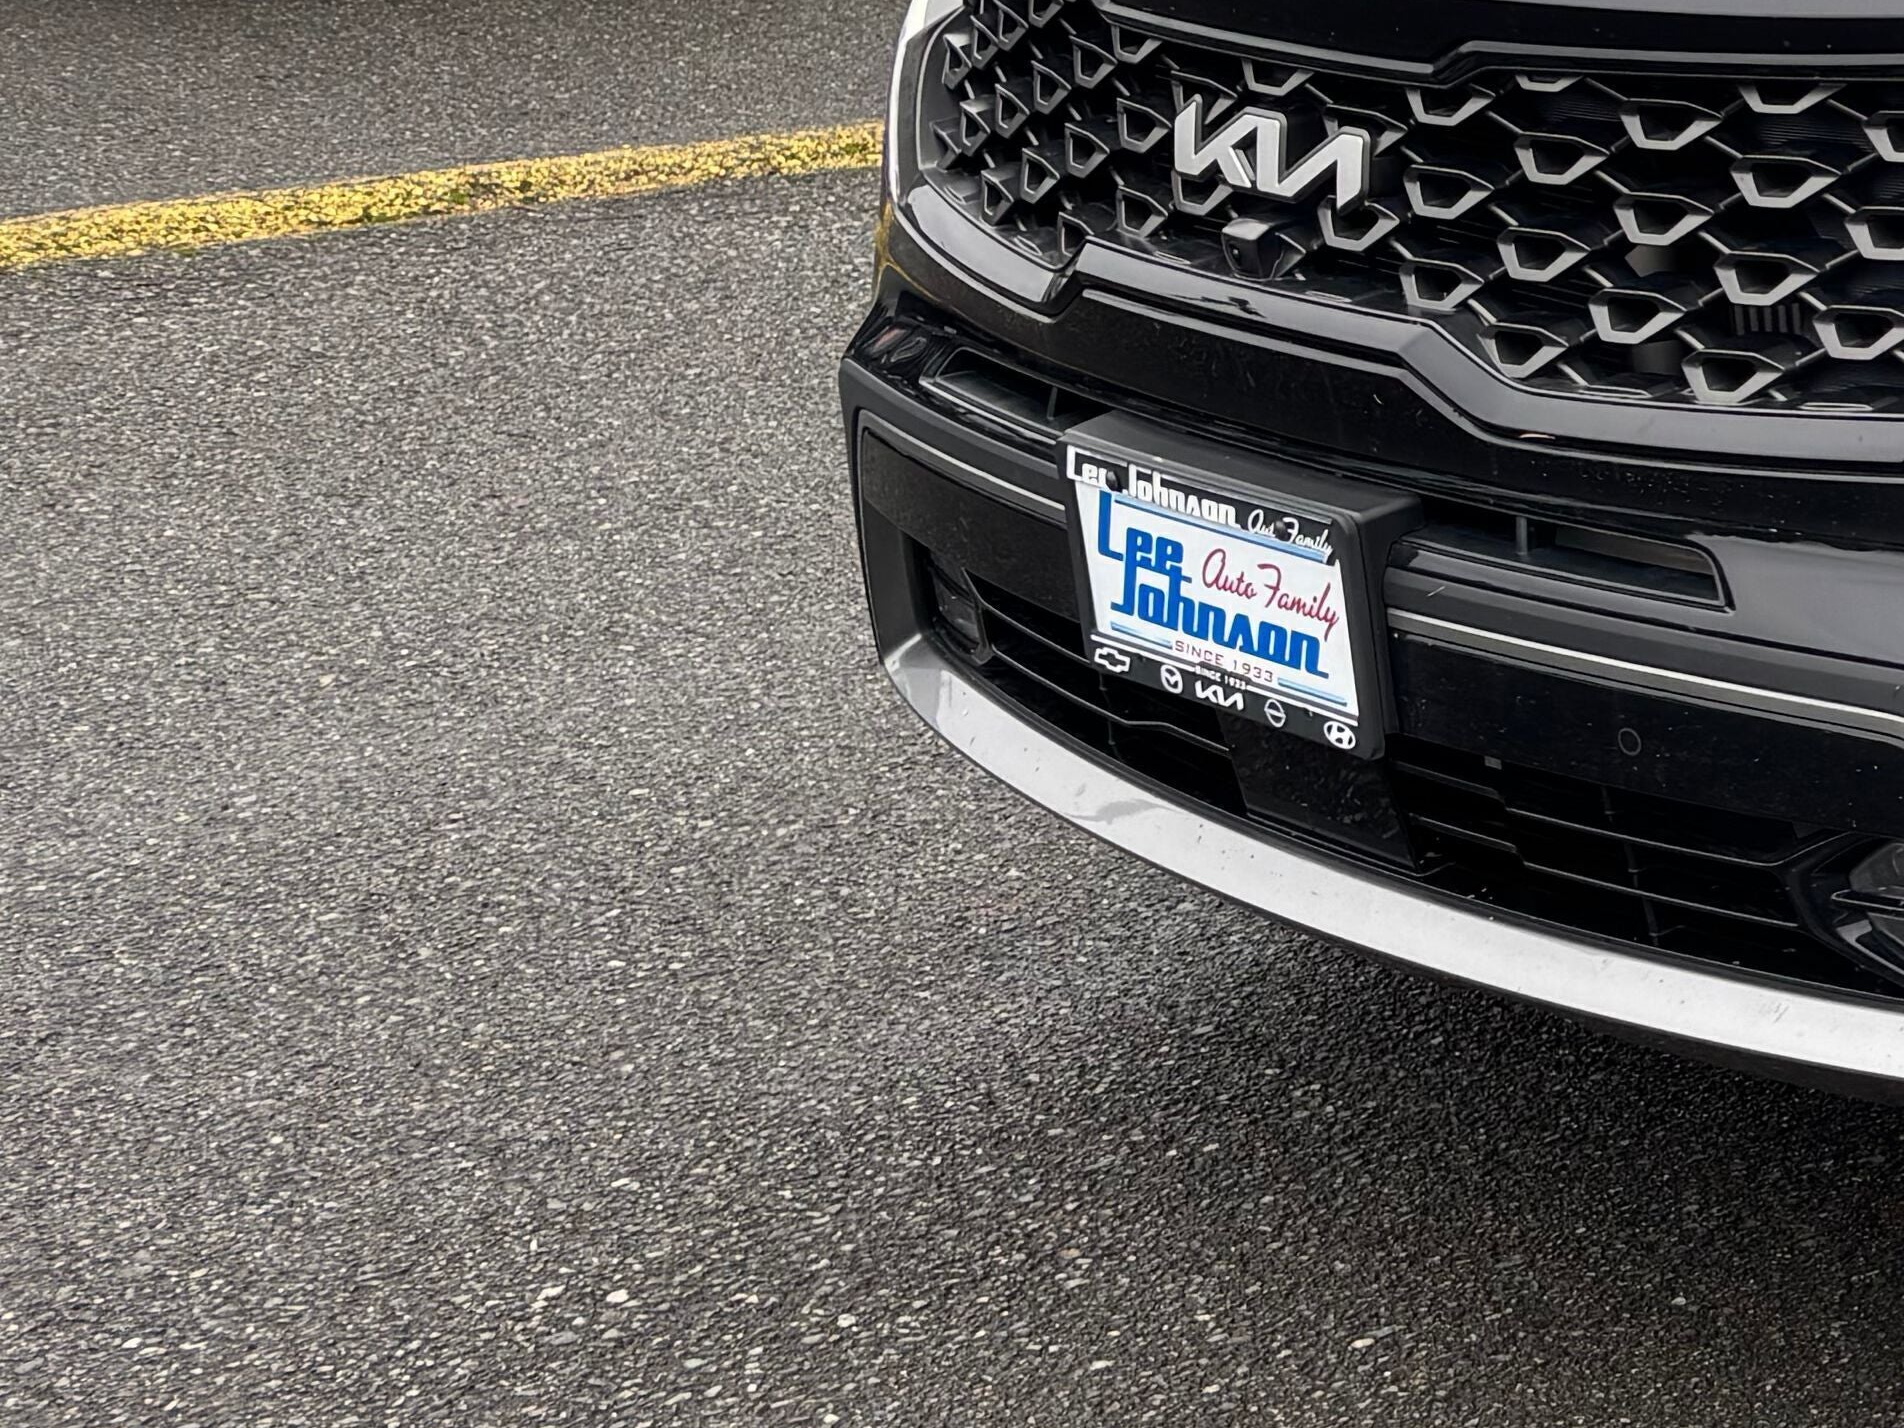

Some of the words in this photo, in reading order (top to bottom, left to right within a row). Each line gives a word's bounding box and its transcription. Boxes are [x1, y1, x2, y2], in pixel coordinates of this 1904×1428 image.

[1098, 489, 1192, 583] Lee
[1122, 464, 1243, 529] Johnson
[1282, 517, 1333, 563] Family
[1110, 560, 1329, 679] Johnson
[1202, 548, 1258, 600] Auto
[1257, 563, 1340, 641] Family
[1174, 640, 1225, 667] SINCE
[1232, 659, 1274, 684] 1933
